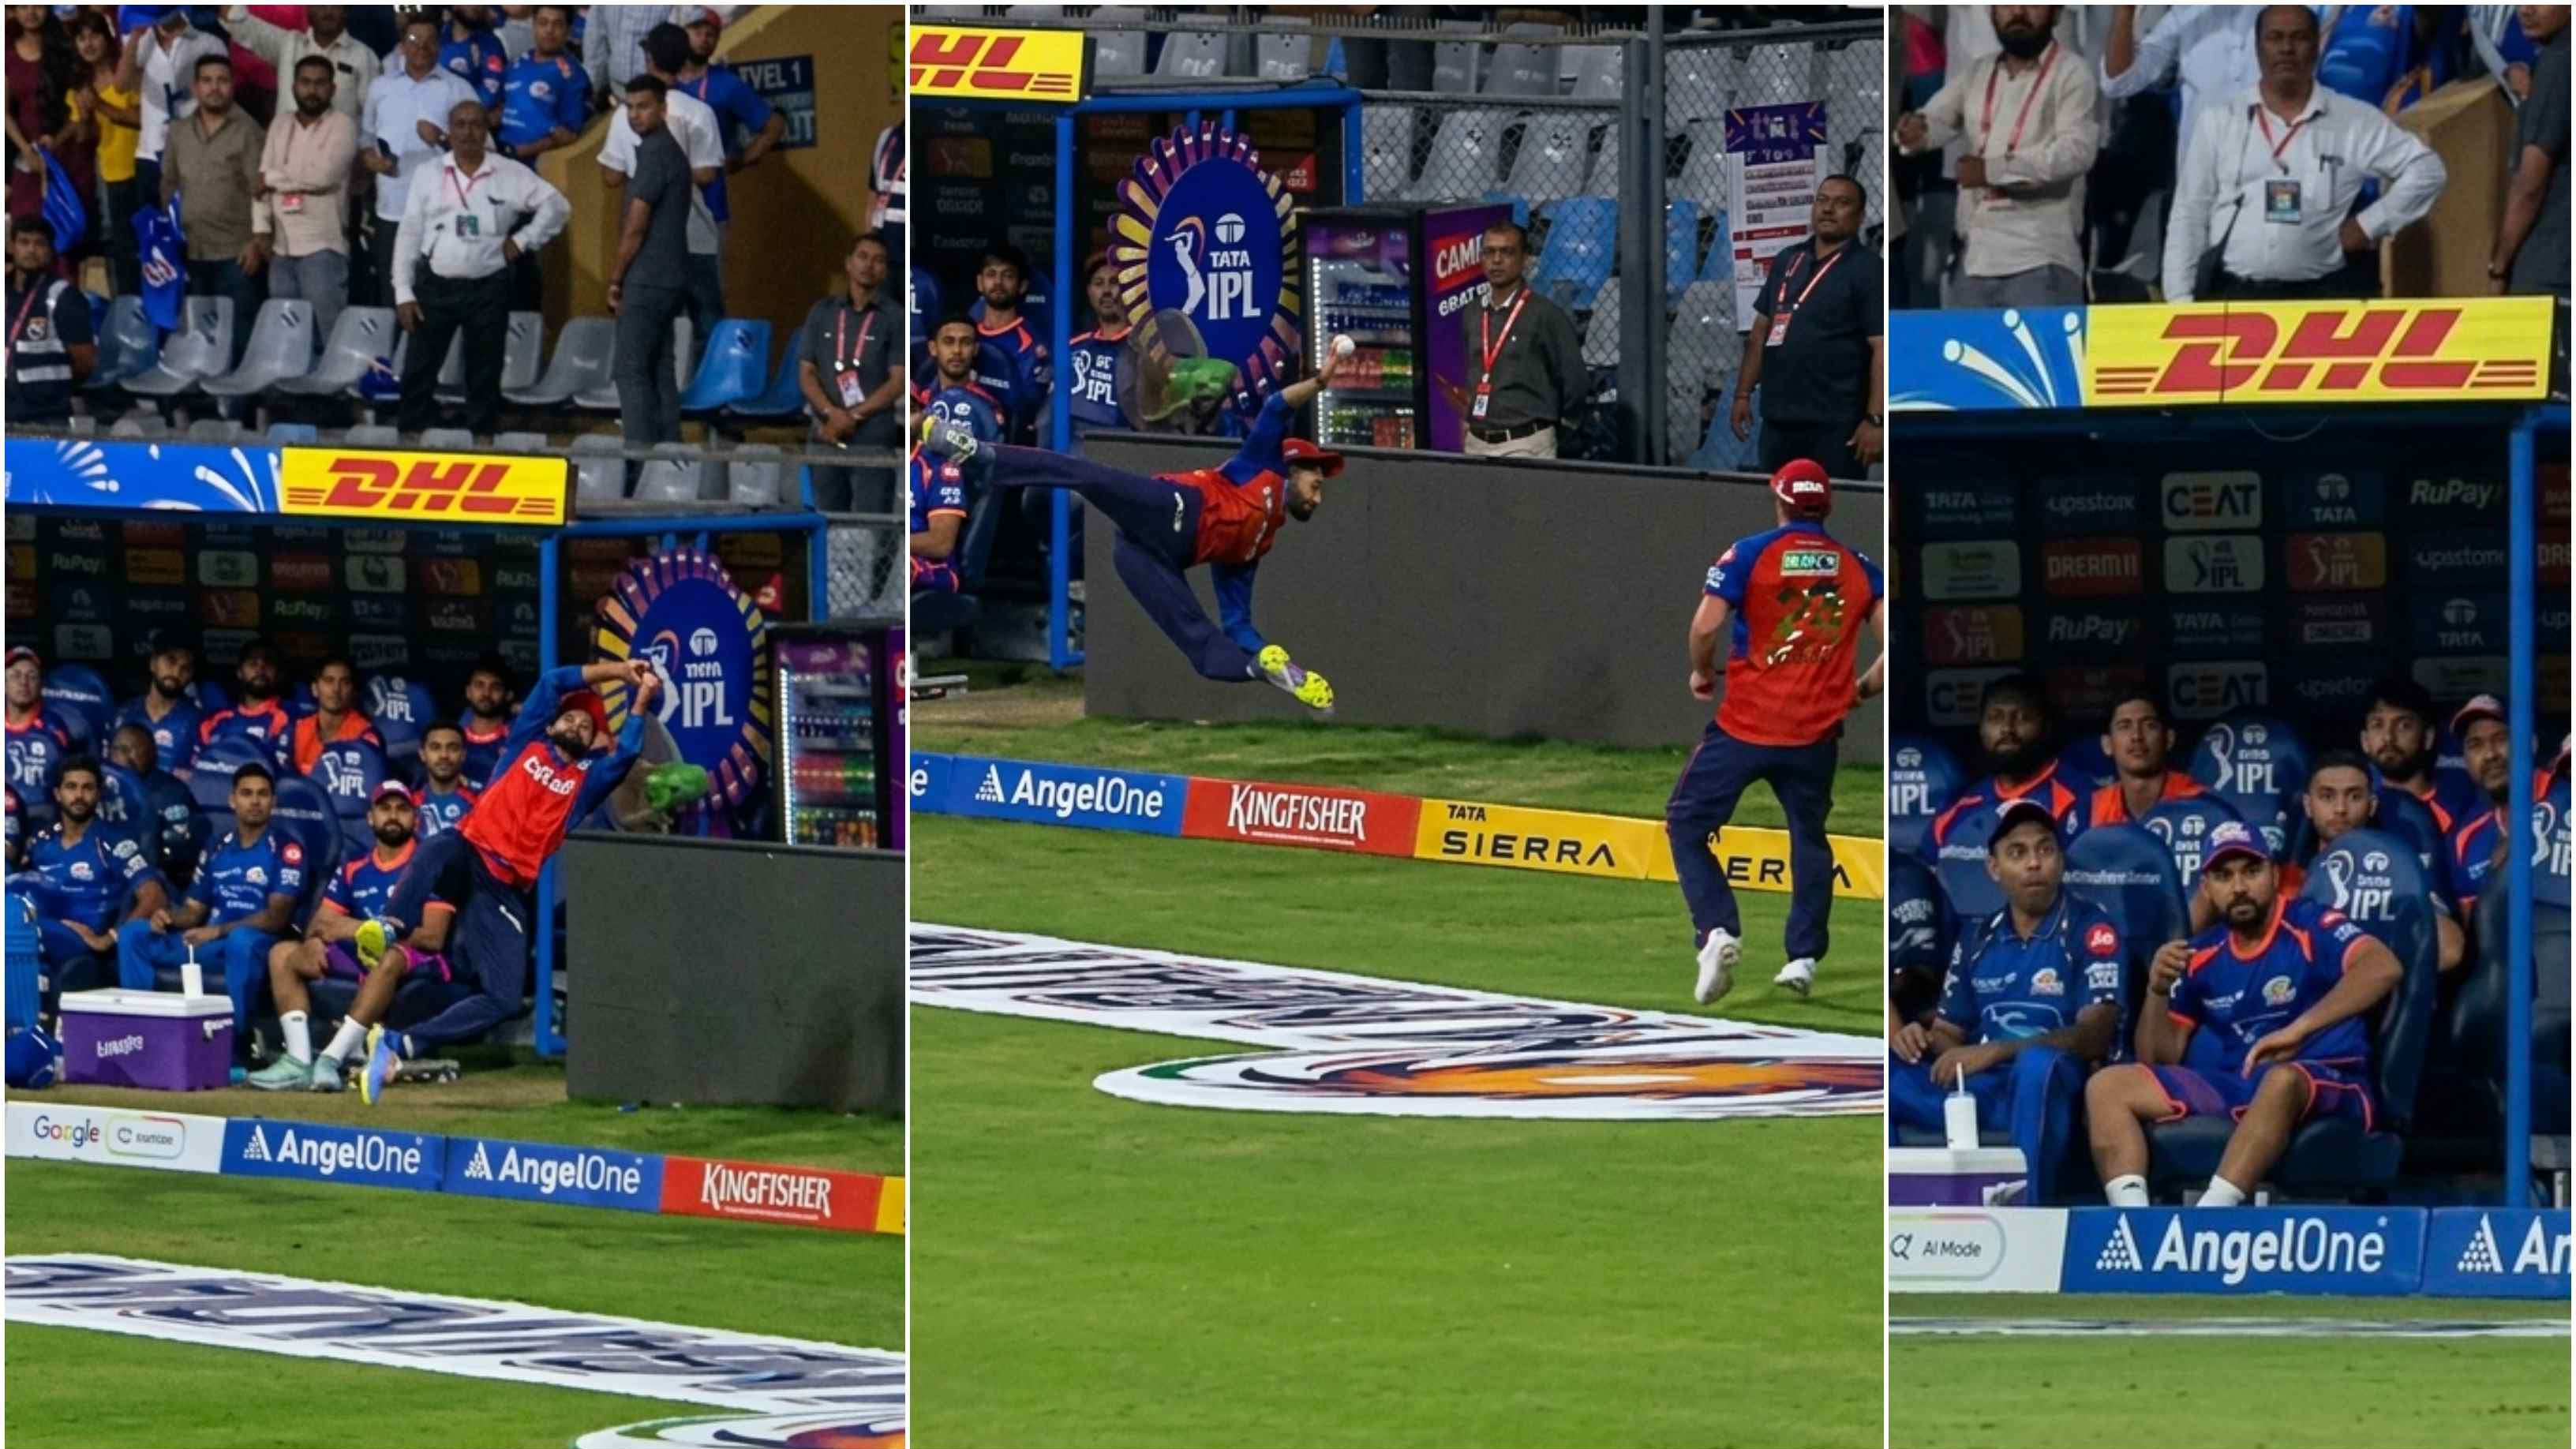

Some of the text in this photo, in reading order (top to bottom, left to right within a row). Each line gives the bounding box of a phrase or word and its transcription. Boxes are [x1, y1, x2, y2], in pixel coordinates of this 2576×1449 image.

[791, 60, 802, 85] 1
[1210, 251, 1250, 267] TATA
[1208, 271, 1261, 320] IPL
[2151, 309, 2481, 392] DHL
[324, 458, 520, 514] DHL
[2168, 485, 2257, 515] CEAT
[2410, 477, 2495, 510] RuPay
[2311, 507, 2357, 524] TATA
[2048, 615, 2129, 644] RuPay
[683, 681, 733, 728] IPL
[1933, 683, 1978, 712] CE
[1012, 767, 1163, 818] AngelOne
[2237, 762, 2280, 794] IPL
[1228, 784, 1365, 841] KINGFISHER
[1447, 804, 1486, 822] TATA
[1890, 784, 1936, 815] IPL
[1443, 831, 1616, 867] SIERRA
[2350, 889, 2395, 921] IPL
[33, 1114, 100, 1148] Google
[277, 1129, 421, 1175] AngelOne
[498, 1146, 641, 1194] AngelOne
[701, 1162, 831, 1218] KINGFISHER
[1923, 1237, 1983, 1258] AI Mode
[2152, 1212, 2385, 1286] AngelOne
